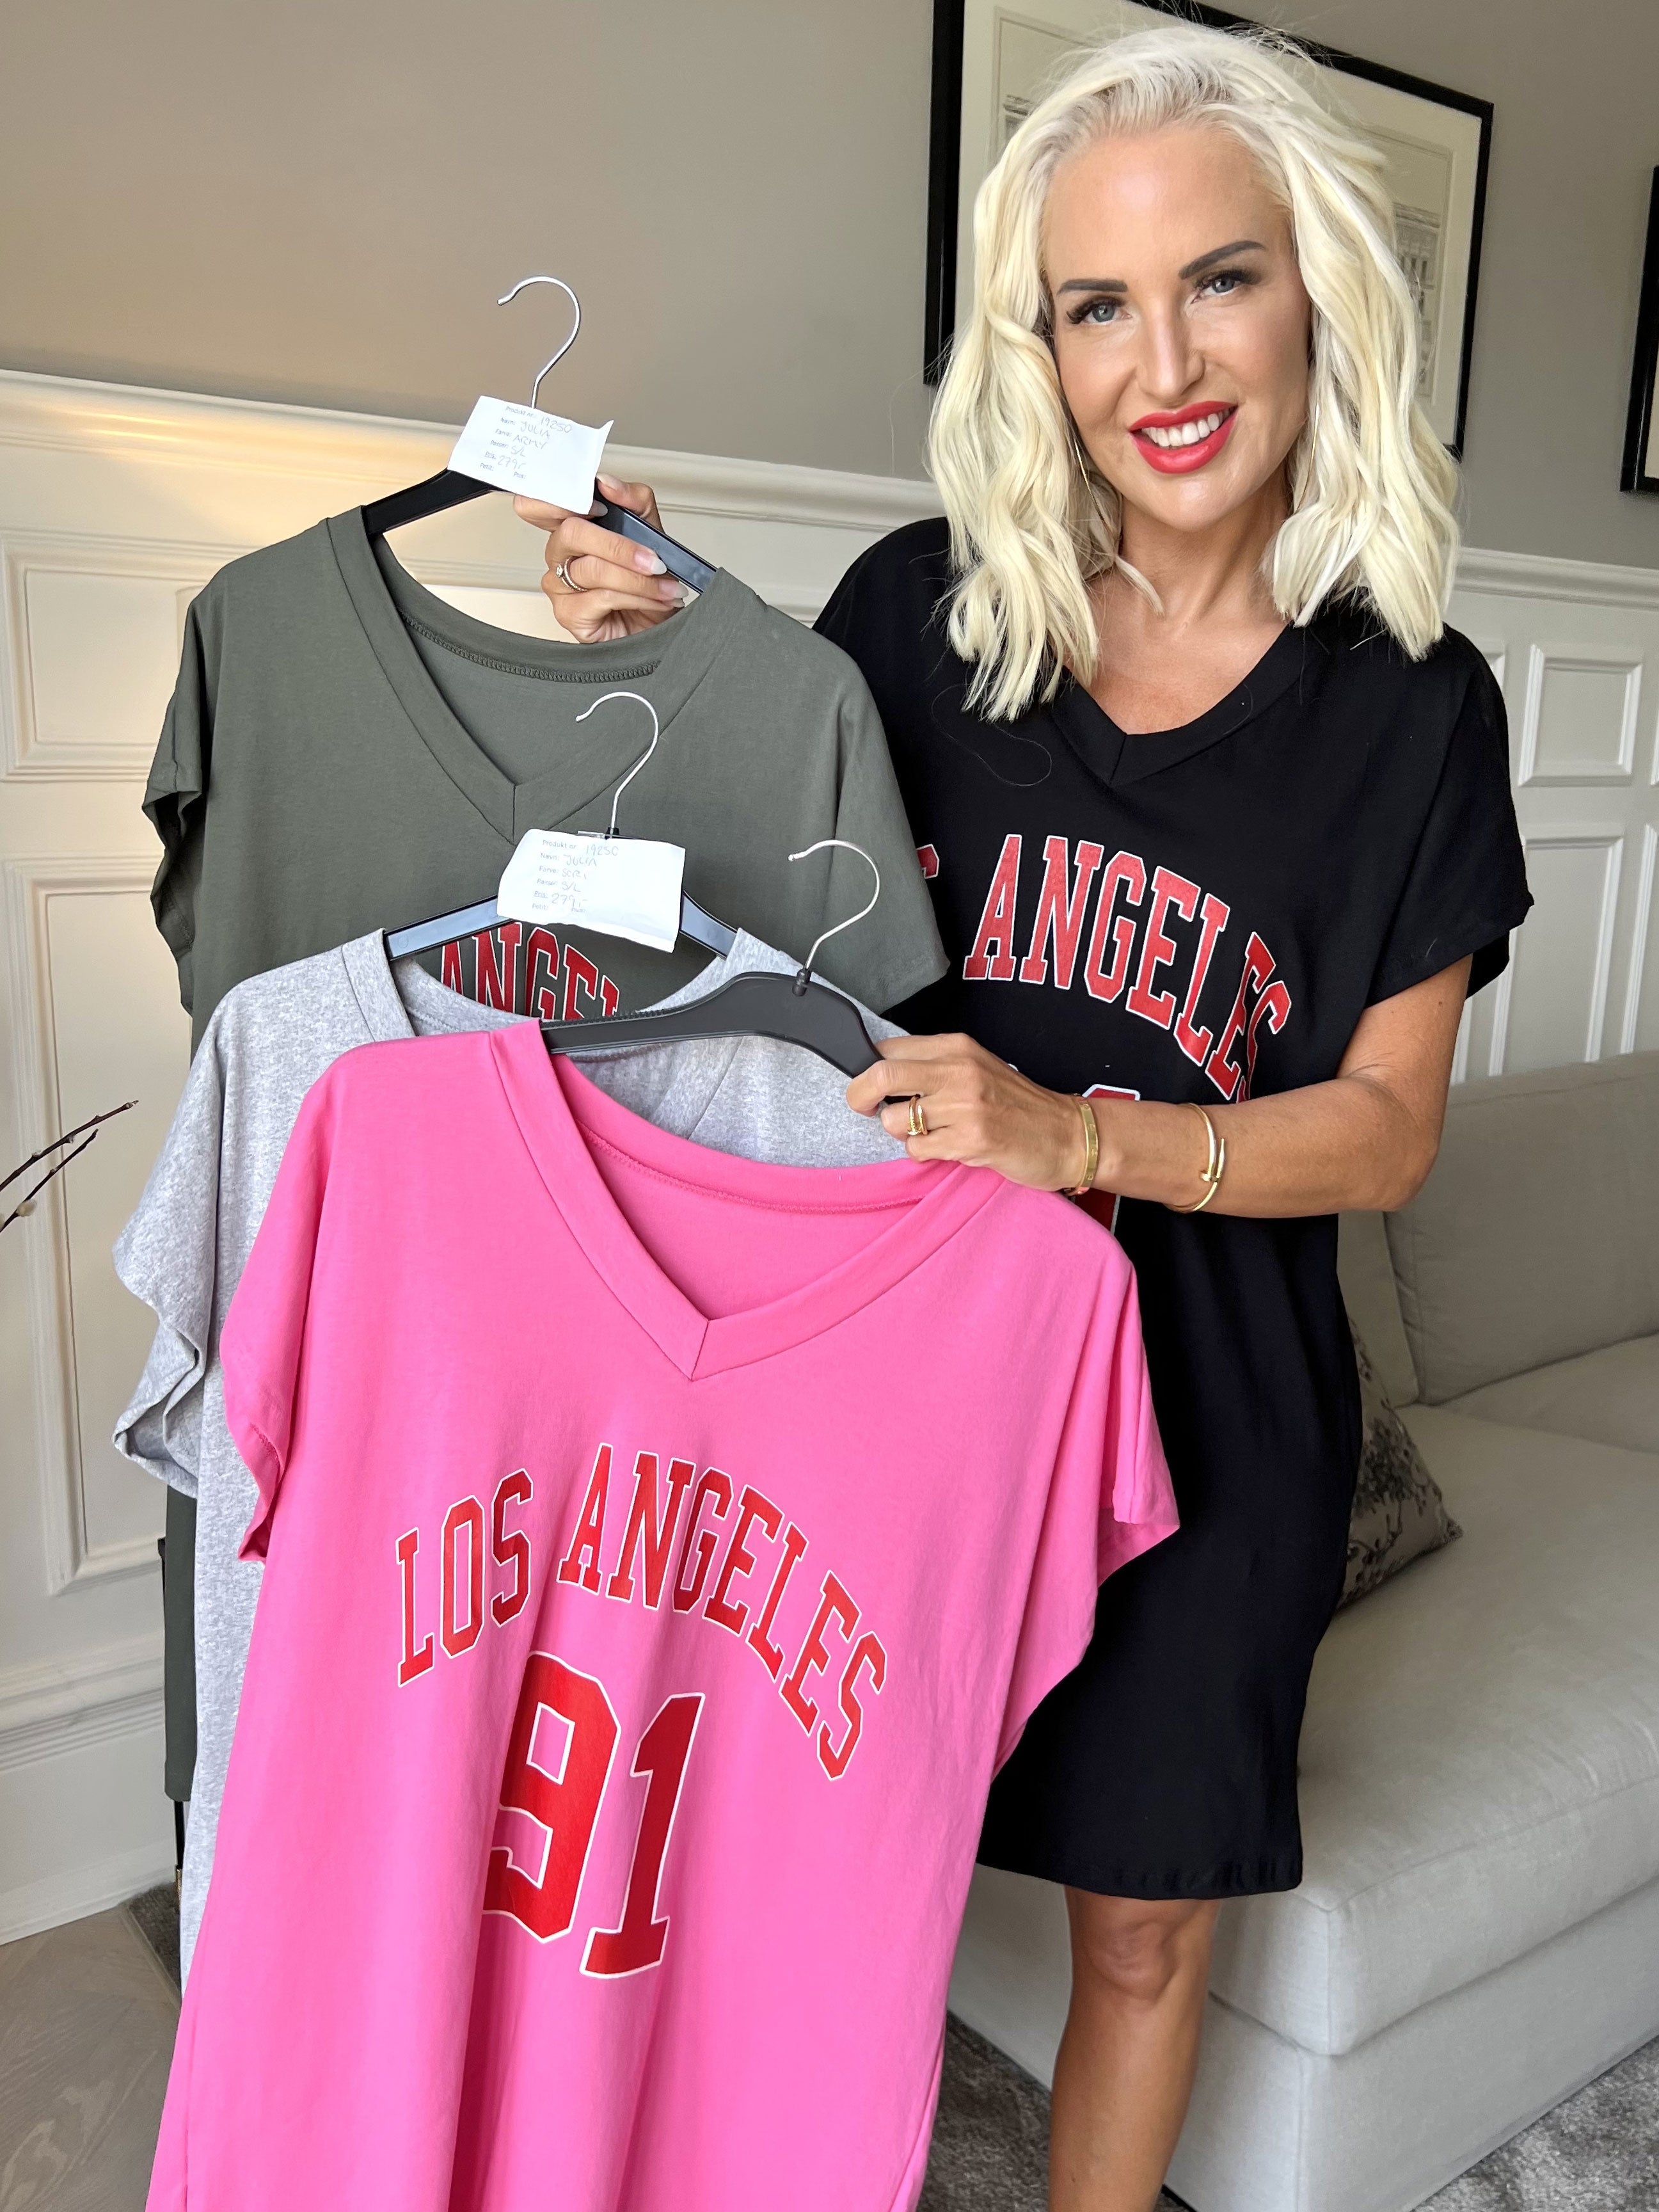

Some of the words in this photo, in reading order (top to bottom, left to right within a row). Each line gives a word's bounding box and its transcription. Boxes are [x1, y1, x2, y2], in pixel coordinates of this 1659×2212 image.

[520, 420, 551, 439] JULIA
[539, 416, 573, 434] 19250
[512, 435, 548, 450] ARMY
[511, 445, 527, 458] S/L
[543, 839, 568, 848] Produkt
[541, 852, 559, 861] Navn:
[539, 865, 559, 873] Farve:
[562, 881, 581, 892] S/L
[962, 834, 1292, 1104] ANGELES
[396, 1468, 534, 1687] LOS
[557, 1442, 888, 1781] ANGELES
[482, 1650, 705, 1979] 91
